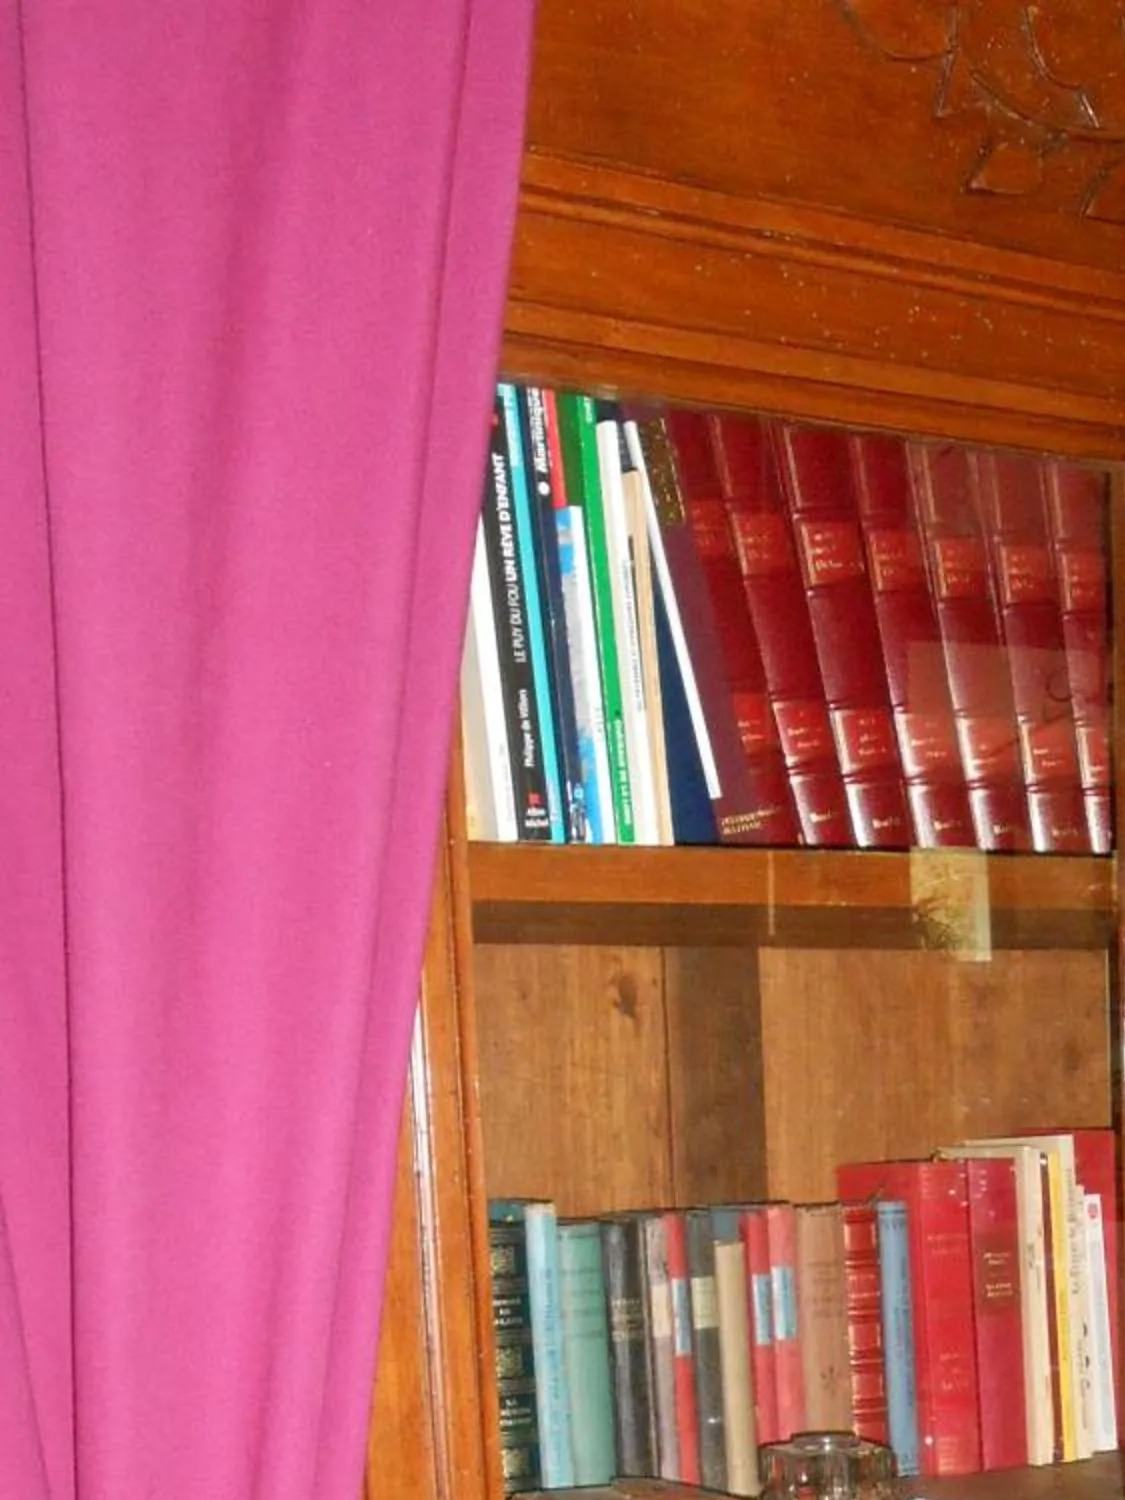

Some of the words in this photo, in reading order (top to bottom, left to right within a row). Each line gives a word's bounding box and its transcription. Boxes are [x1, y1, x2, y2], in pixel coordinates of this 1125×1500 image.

[503, 558, 518, 583] UN
[507, 584, 520, 606] FOU
[509, 608, 523, 626] DU
[511, 626, 525, 649] PUY
[513, 649, 527, 664] LE
